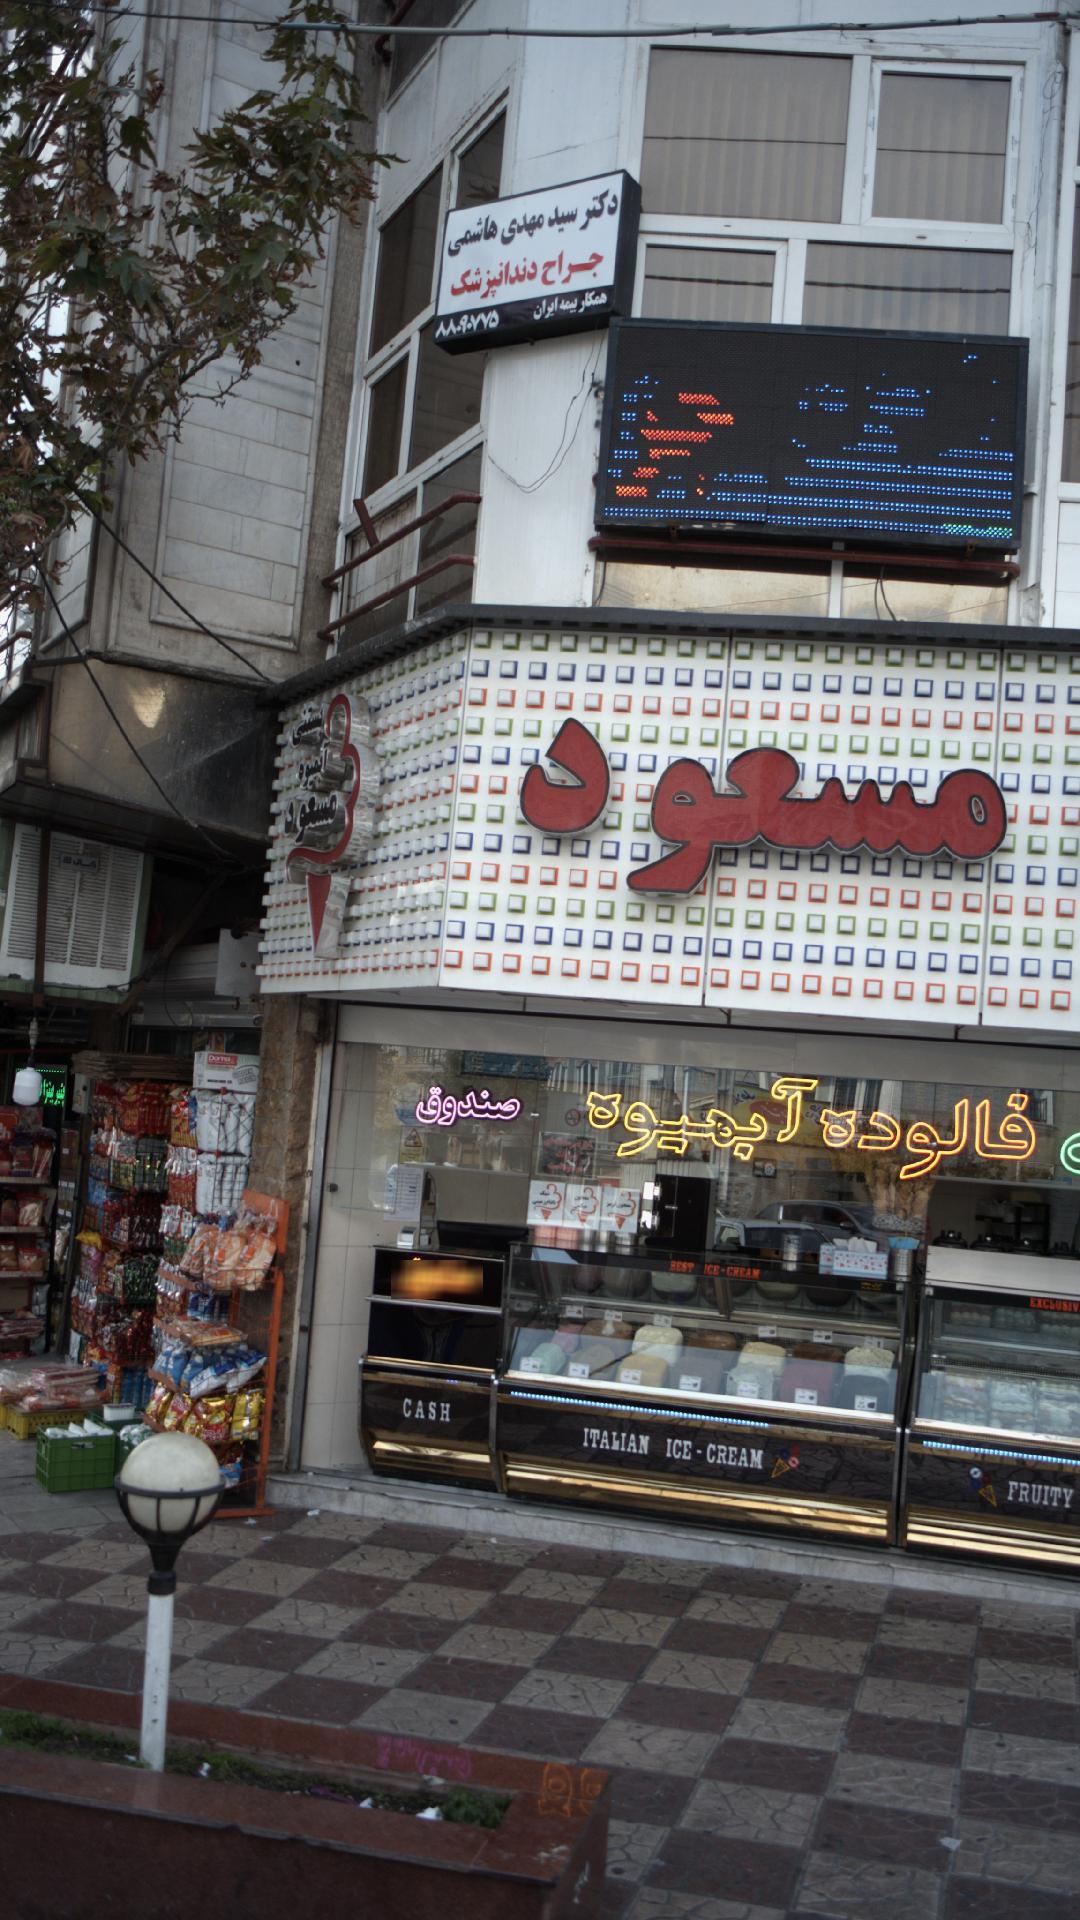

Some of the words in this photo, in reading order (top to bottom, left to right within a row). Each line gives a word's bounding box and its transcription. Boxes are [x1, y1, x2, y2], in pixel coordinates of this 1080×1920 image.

[547, 205, 578, 232] سید
[579, 189, 618, 231] دکتر
[448, 214, 498, 256] هاشمی
[500, 211, 545, 245] مهدی
[451, 258, 539, 299] دندانپزشک
[540, 250, 604, 285] جراح
[532, 297, 558, 320] ایران
[559, 297, 578, 314] بیمه
[577, 291, 608, 314] همکار
[285, 793, 338, 845] مسعود
[520, 717, 1008, 895] مسعود
[416, 1086, 521, 1126] صندوق
[820, 1094, 1036, 1180] فالوده
[671, 1260, 695, 1273] BEST
[402, 1398, 451, 1422] CASH
[583, 1427, 650, 1455] ITALIAN
[1007, 1480, 1074, 1509] FRUITY
